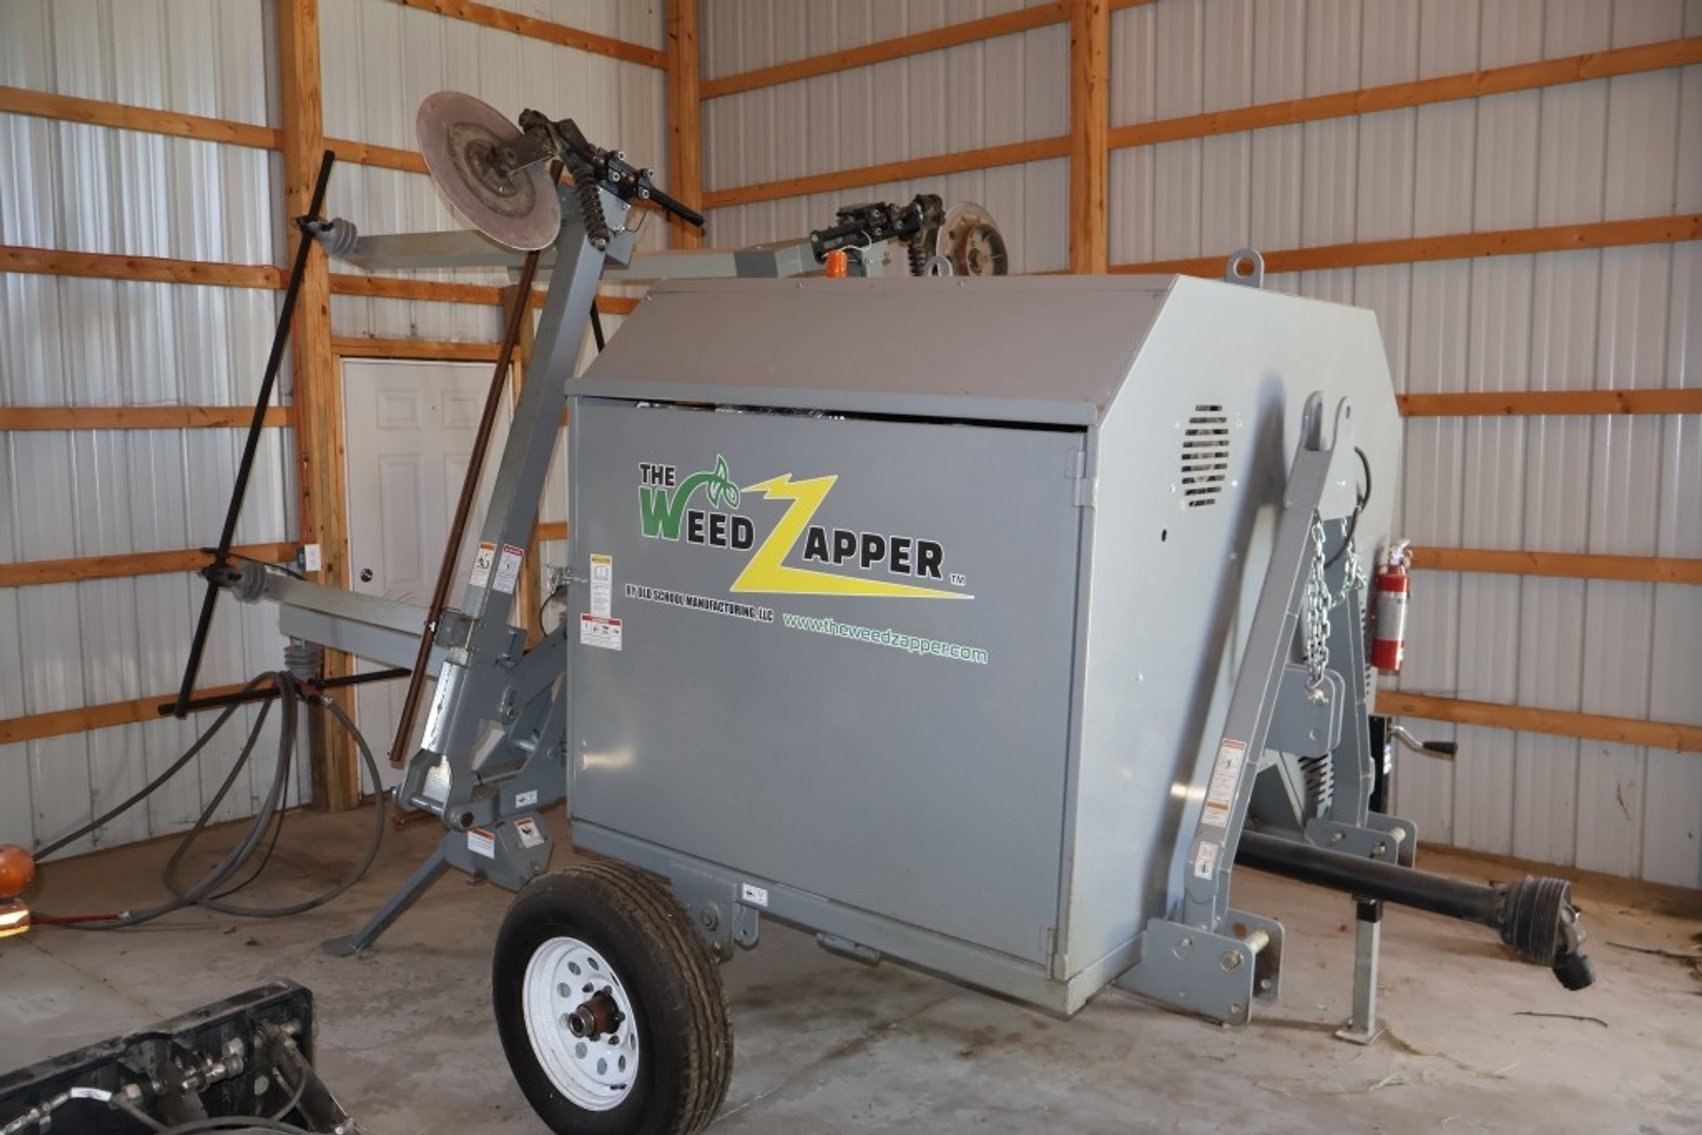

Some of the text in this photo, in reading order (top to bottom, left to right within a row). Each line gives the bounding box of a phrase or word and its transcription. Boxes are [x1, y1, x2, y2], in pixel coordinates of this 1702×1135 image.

[638, 462, 676, 487] THE
[638, 472, 755, 551] WEED
[730, 473, 974, 598] ZAPPER
[652, 589, 684, 606] SCHOOL
[758, 607, 774, 623] LLC
[783, 612, 989, 665] www.theweedzapper.com
